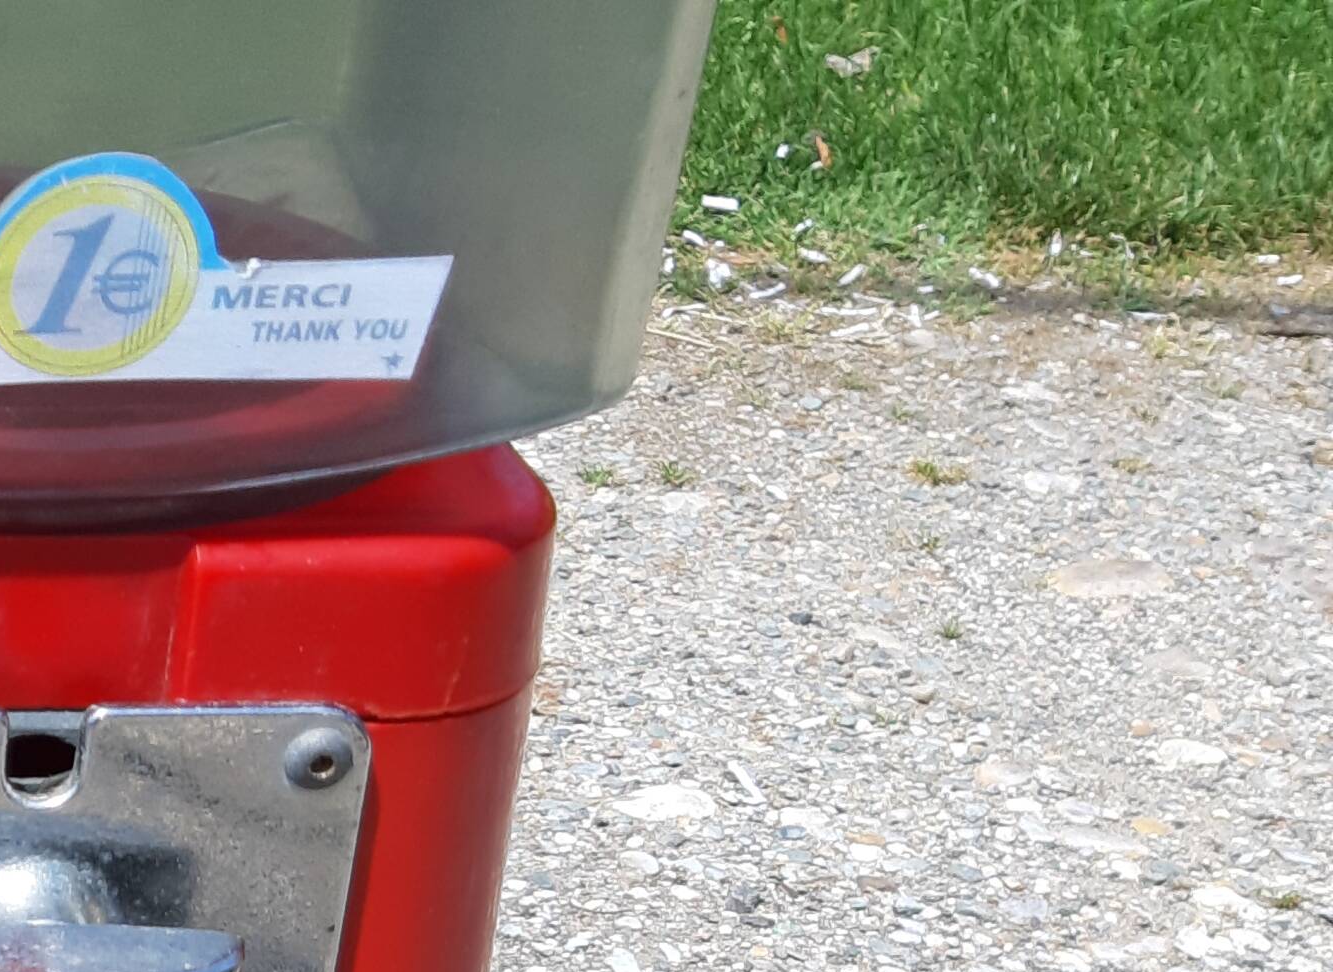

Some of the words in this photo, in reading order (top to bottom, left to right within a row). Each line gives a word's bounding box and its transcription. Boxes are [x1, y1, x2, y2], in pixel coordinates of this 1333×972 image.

[211, 284, 352, 310] MERCI
[251, 320, 340, 343] THANK
[353, 318, 408, 341] YOU
